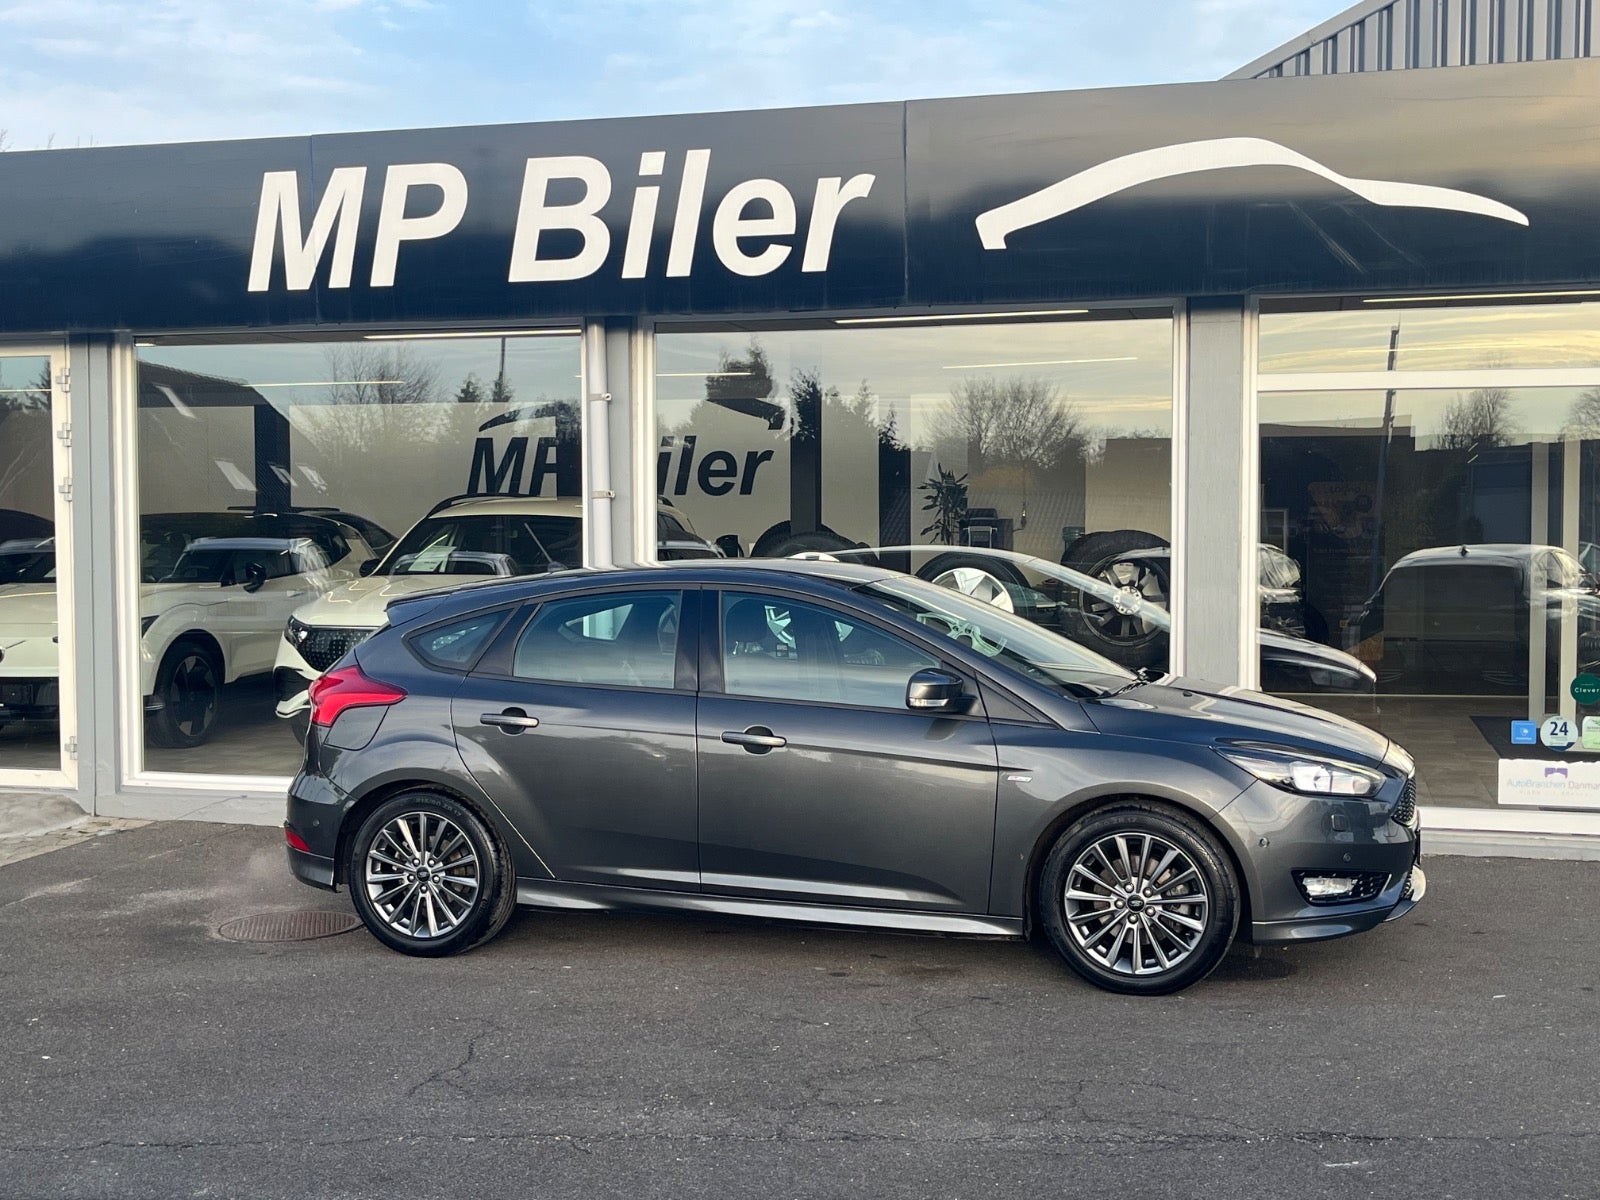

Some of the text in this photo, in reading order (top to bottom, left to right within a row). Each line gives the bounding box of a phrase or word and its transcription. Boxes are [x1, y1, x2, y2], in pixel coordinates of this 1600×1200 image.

[247, 147, 877, 293] MP Biler
[657, 435, 775, 497] iler
[1549, 721, 1569, 736] 24
[1506, 777, 1566, 788] AutoBranchen
